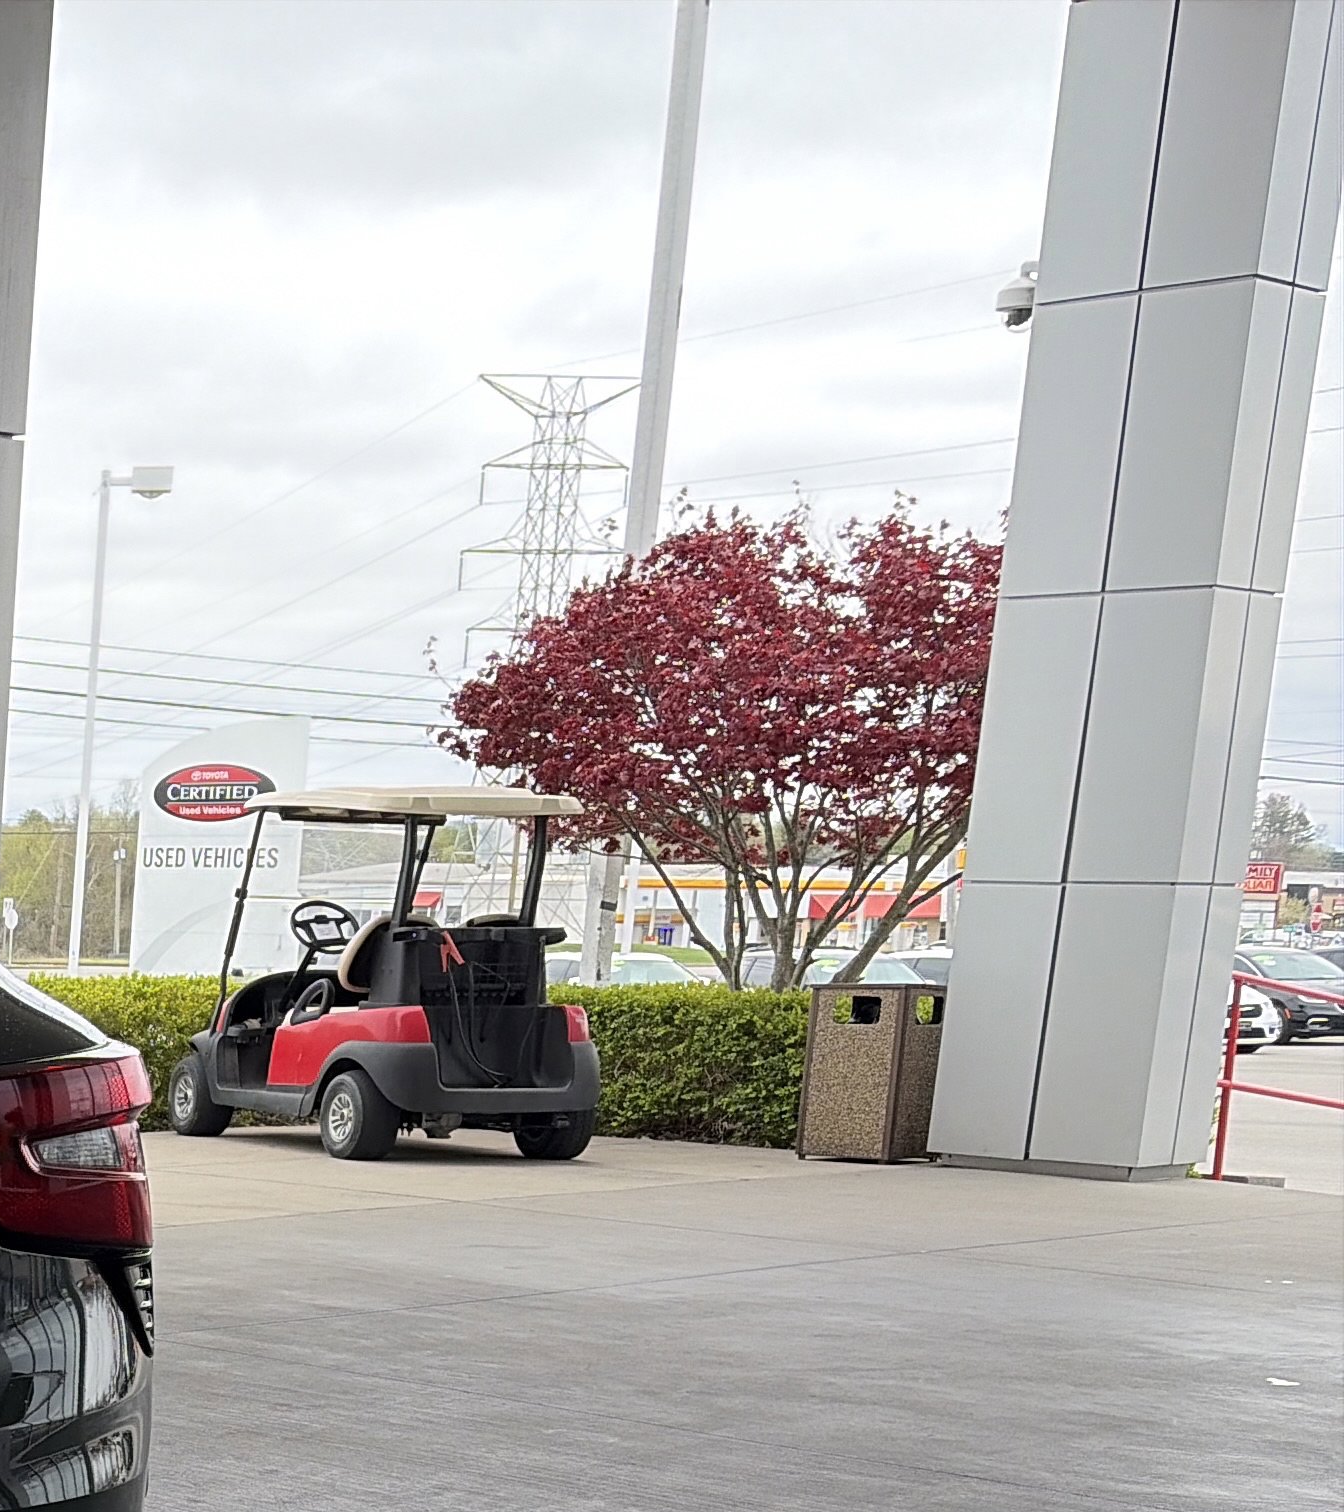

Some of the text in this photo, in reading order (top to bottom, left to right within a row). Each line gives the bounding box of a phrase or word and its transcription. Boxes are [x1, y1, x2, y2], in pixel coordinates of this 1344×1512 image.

[202, 770, 229, 780] TOYOTA
[167, 784, 258, 800] CERTIFIED
[179, 806, 241, 815] Used Vehicles
[143, 848, 279, 868] USED VEHICES
